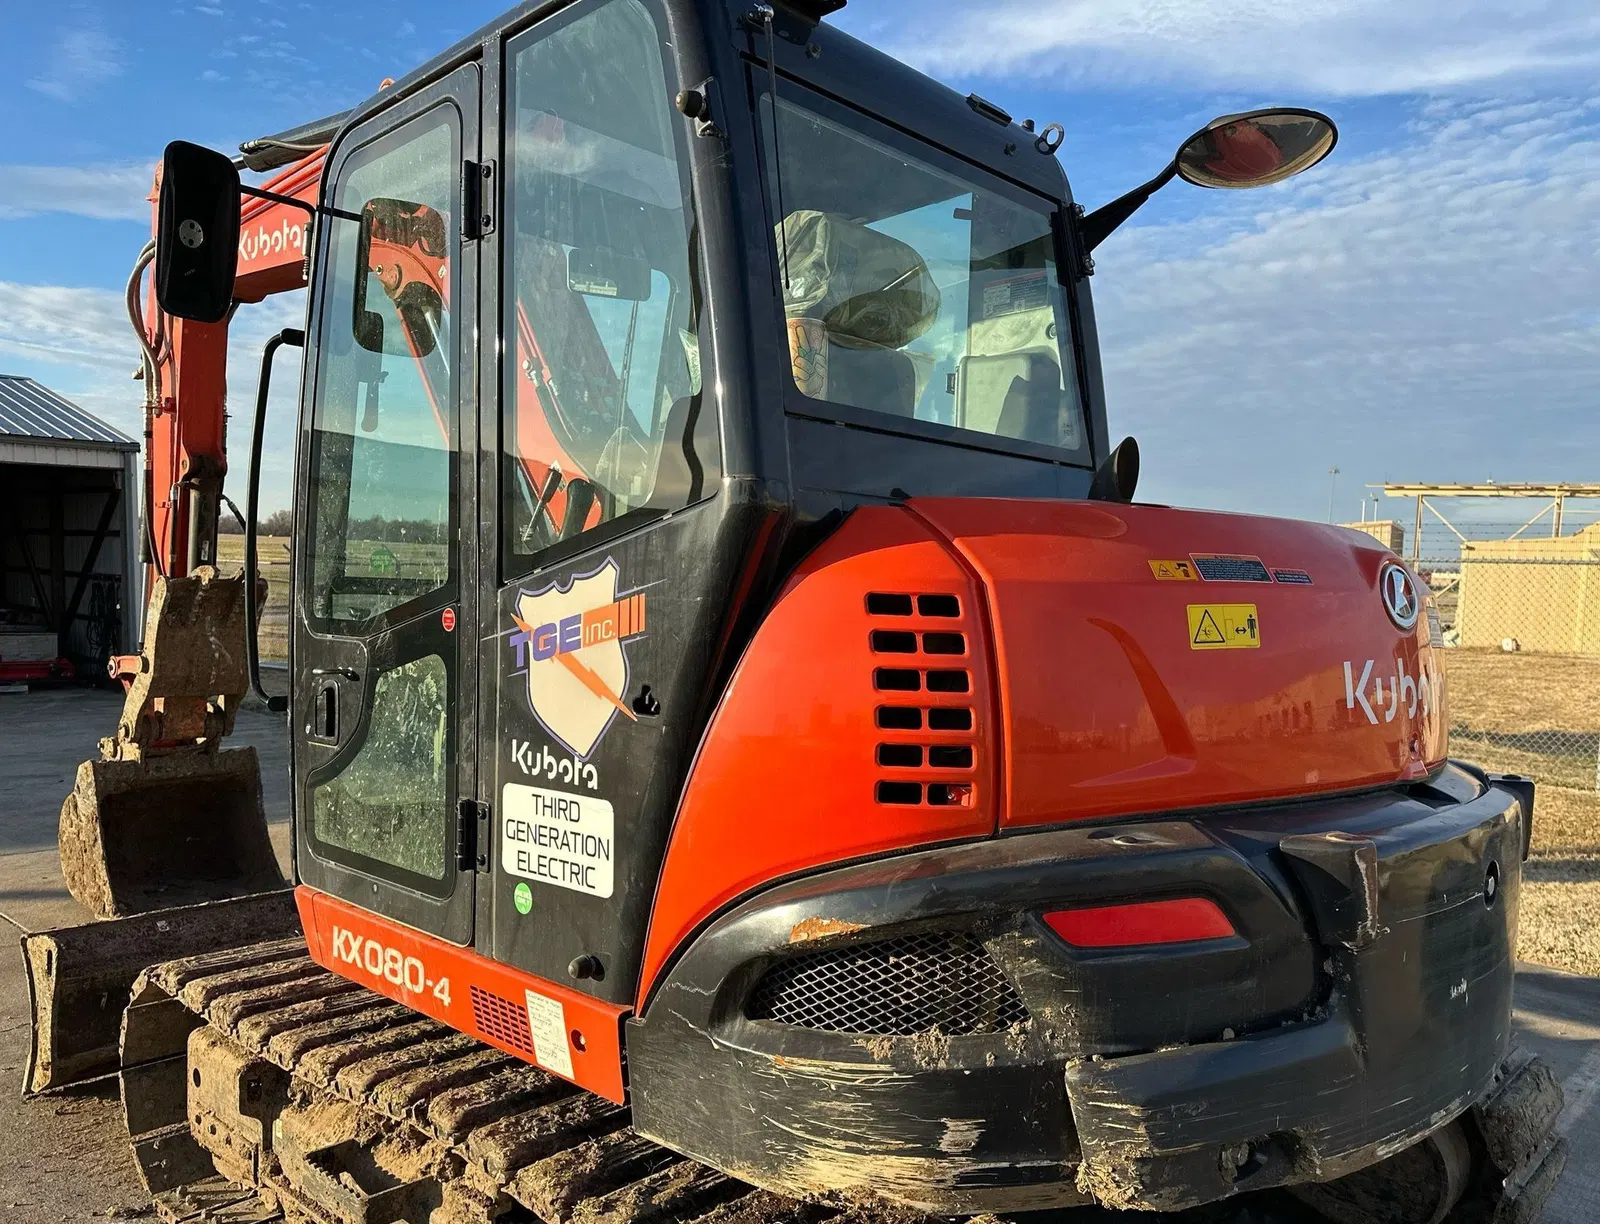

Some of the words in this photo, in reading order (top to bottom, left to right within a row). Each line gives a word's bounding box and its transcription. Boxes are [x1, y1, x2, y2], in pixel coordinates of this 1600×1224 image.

[238, 218, 302, 261] Kubota
[509, 613, 582, 668] TGE
[511, 738, 598, 790] Kubota
[531, 793, 581, 823] THIRD
[505, 818, 610, 861] GENERATION
[517, 850, 596, 889] ELECTRIC
[332, 925, 452, 1007] KX080-4
